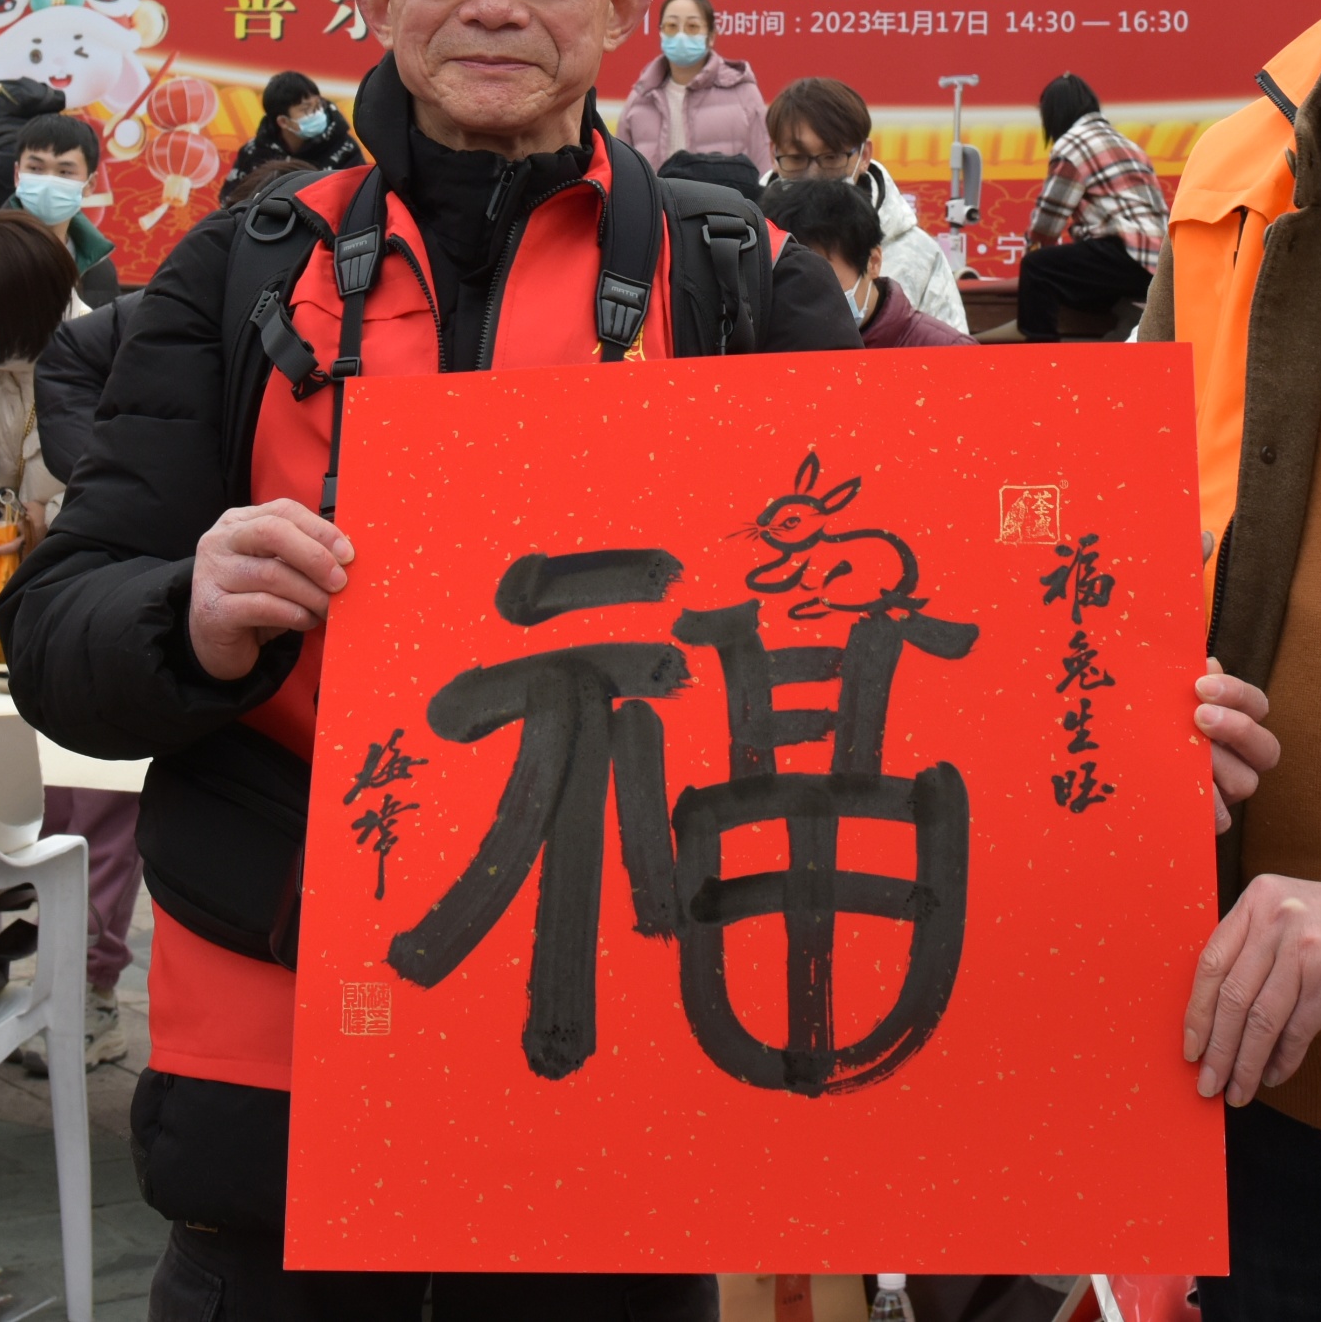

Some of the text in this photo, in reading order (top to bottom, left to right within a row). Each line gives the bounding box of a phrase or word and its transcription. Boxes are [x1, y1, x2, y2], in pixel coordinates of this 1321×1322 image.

[1006, 10, 1076, 33] 14:30
[1117, 9, 1189, 33] 16:30
[384, 547, 980, 1098] 福
